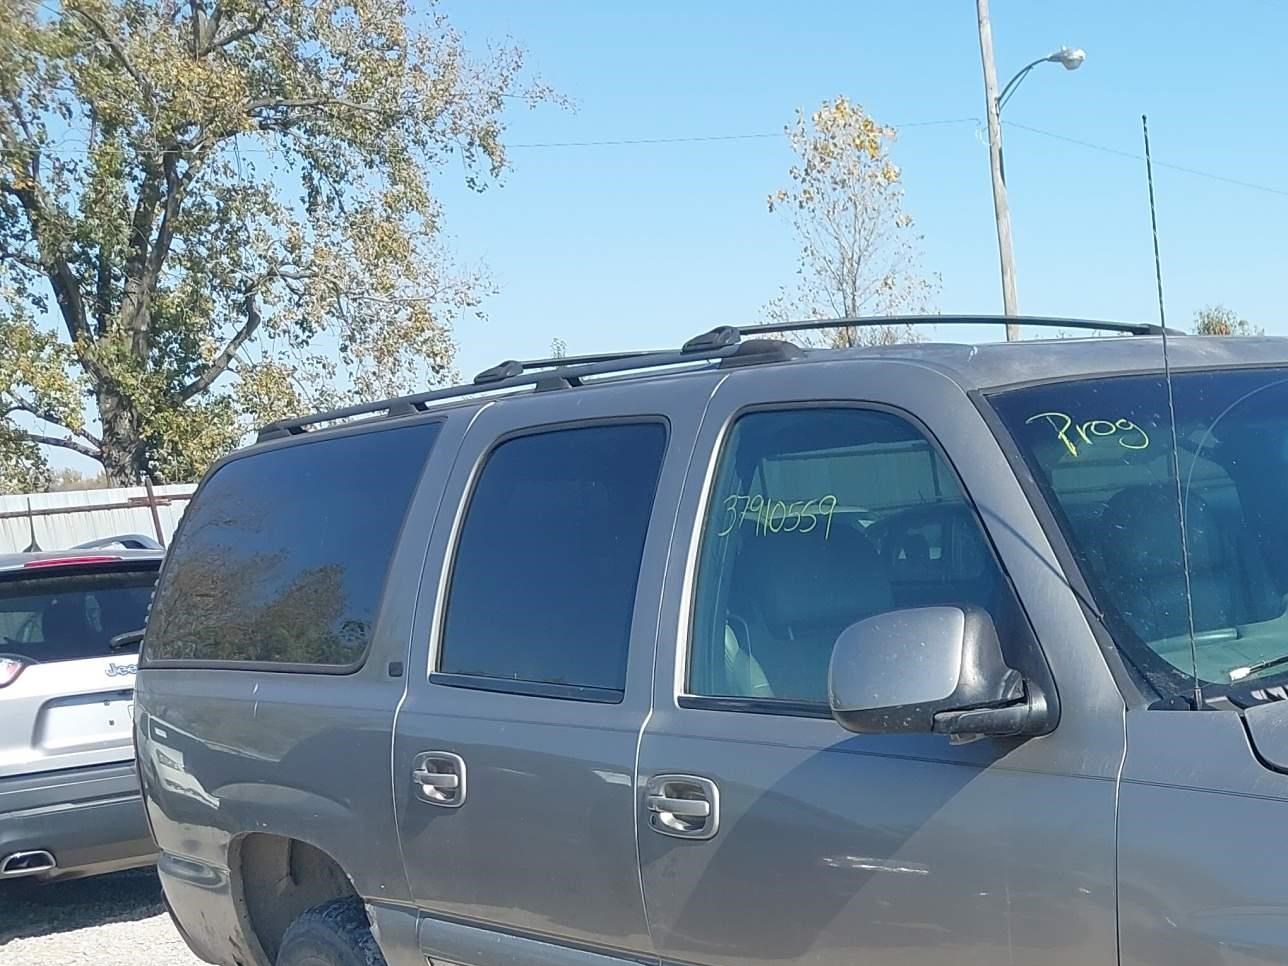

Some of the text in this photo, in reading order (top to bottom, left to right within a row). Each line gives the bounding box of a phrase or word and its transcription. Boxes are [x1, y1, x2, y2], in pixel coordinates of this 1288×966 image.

[1024, 411, 1150, 457] Prog
[717, 494, 837, 540] 37910559
[104, 662, 138, 678] Jee
